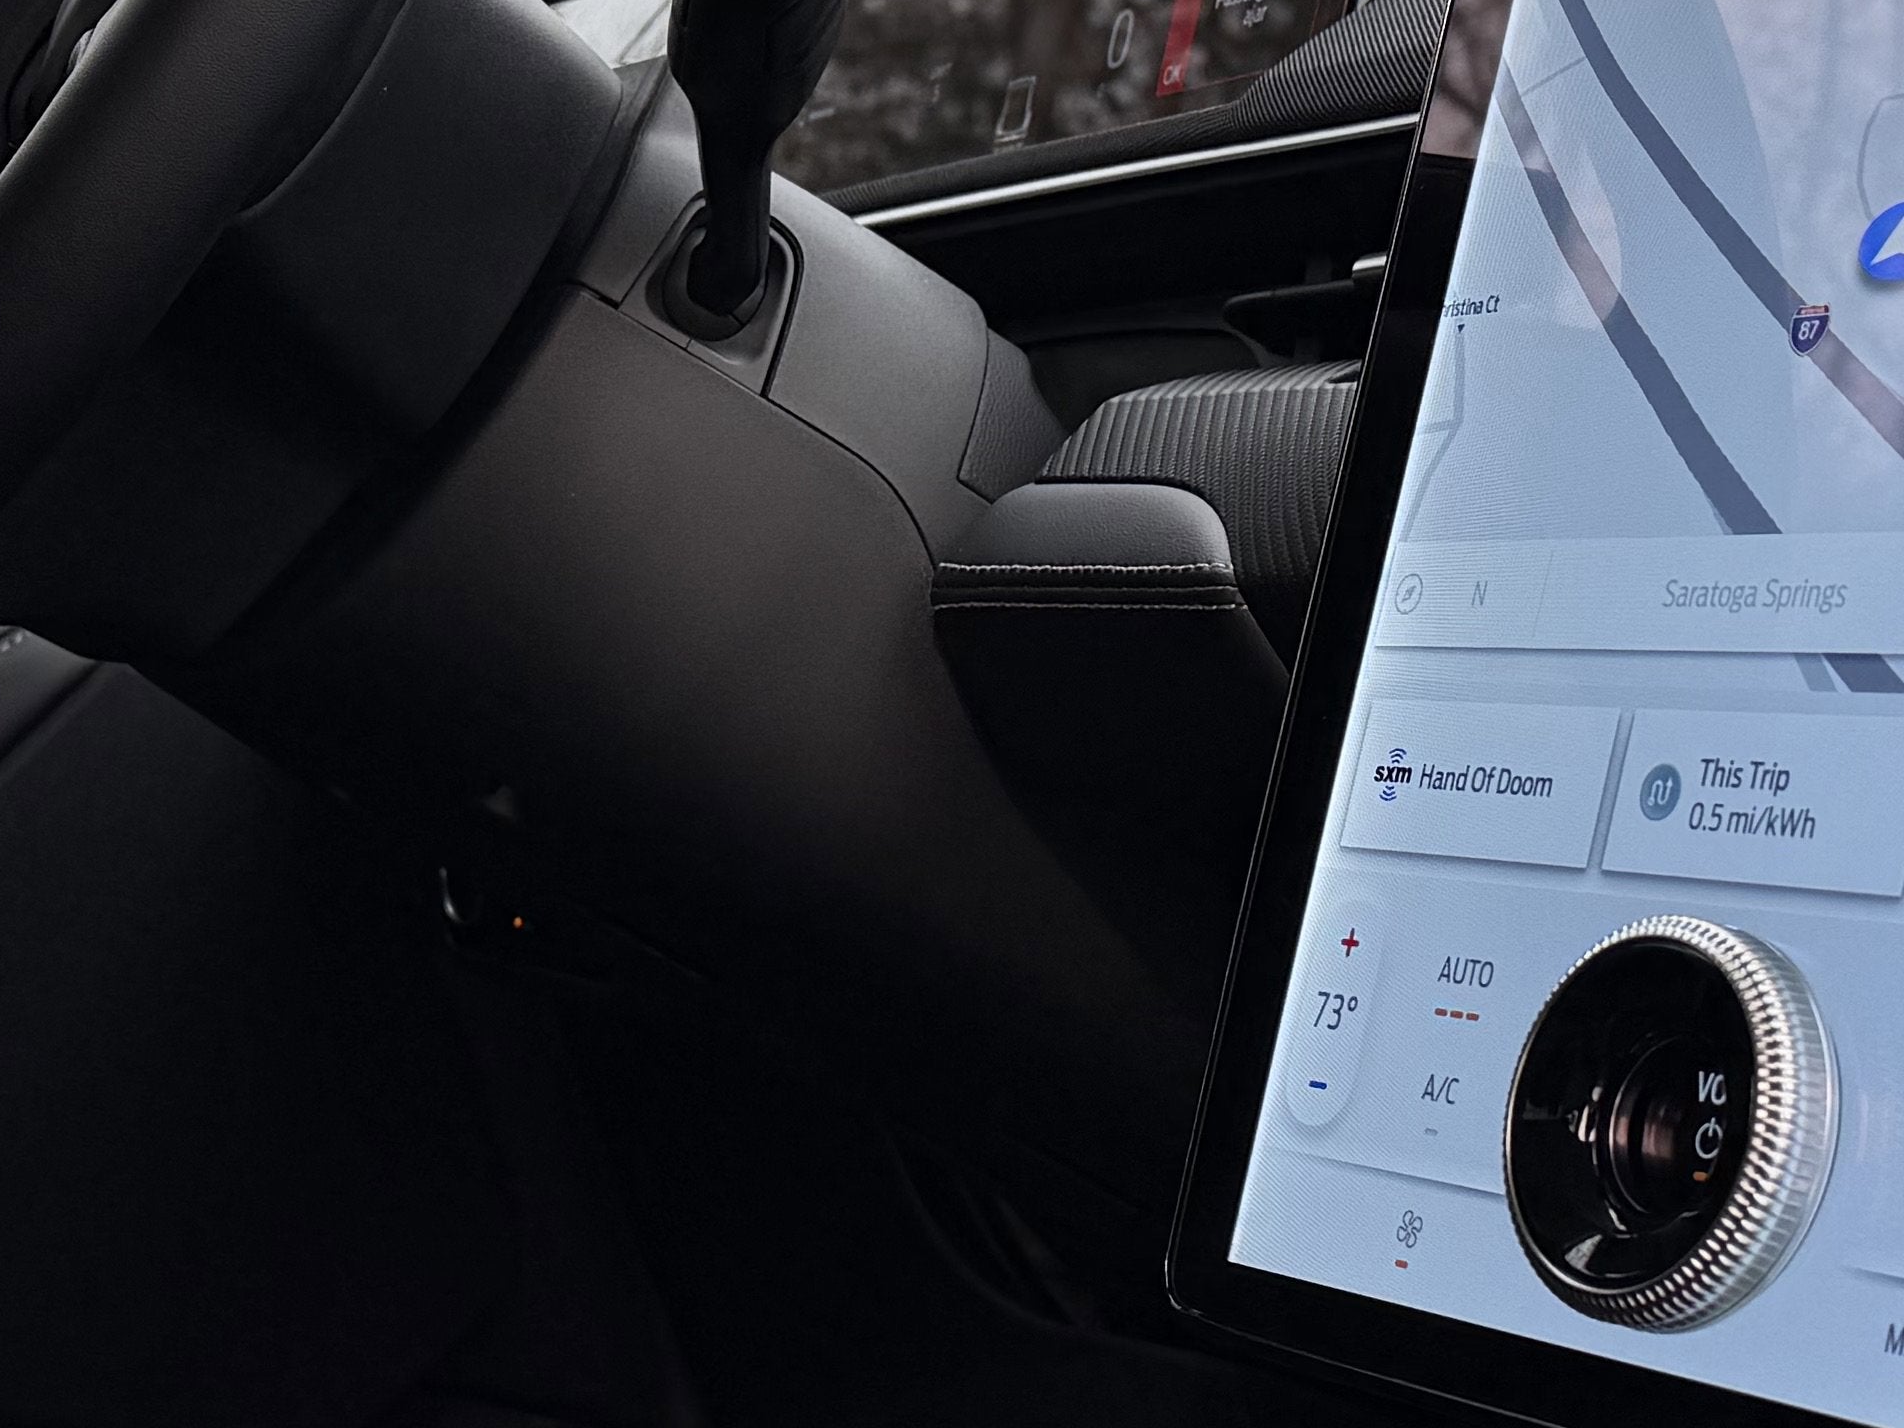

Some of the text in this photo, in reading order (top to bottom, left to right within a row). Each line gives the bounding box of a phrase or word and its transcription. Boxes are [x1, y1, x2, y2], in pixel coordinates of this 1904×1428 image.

[1486, 294, 1500, 313] Ct
[1798, 320, 1820, 340] 87
[1471, 580, 1488, 607] N
[1662, 578, 1848, 614] Saratoga Springs
[1374, 765, 1412, 784] sxm
[1419, 764, 1553, 798] Hand Of Doom
[1700, 757, 1790, 797] This Trip
[1688, 802, 1816, 839] 0.5 mi/kWh
[1437, 956, 1494, 988] AUTO
[1313, 990, 1359, 1031] 73°
[1421, 1073, 1460, 1105] A/C
